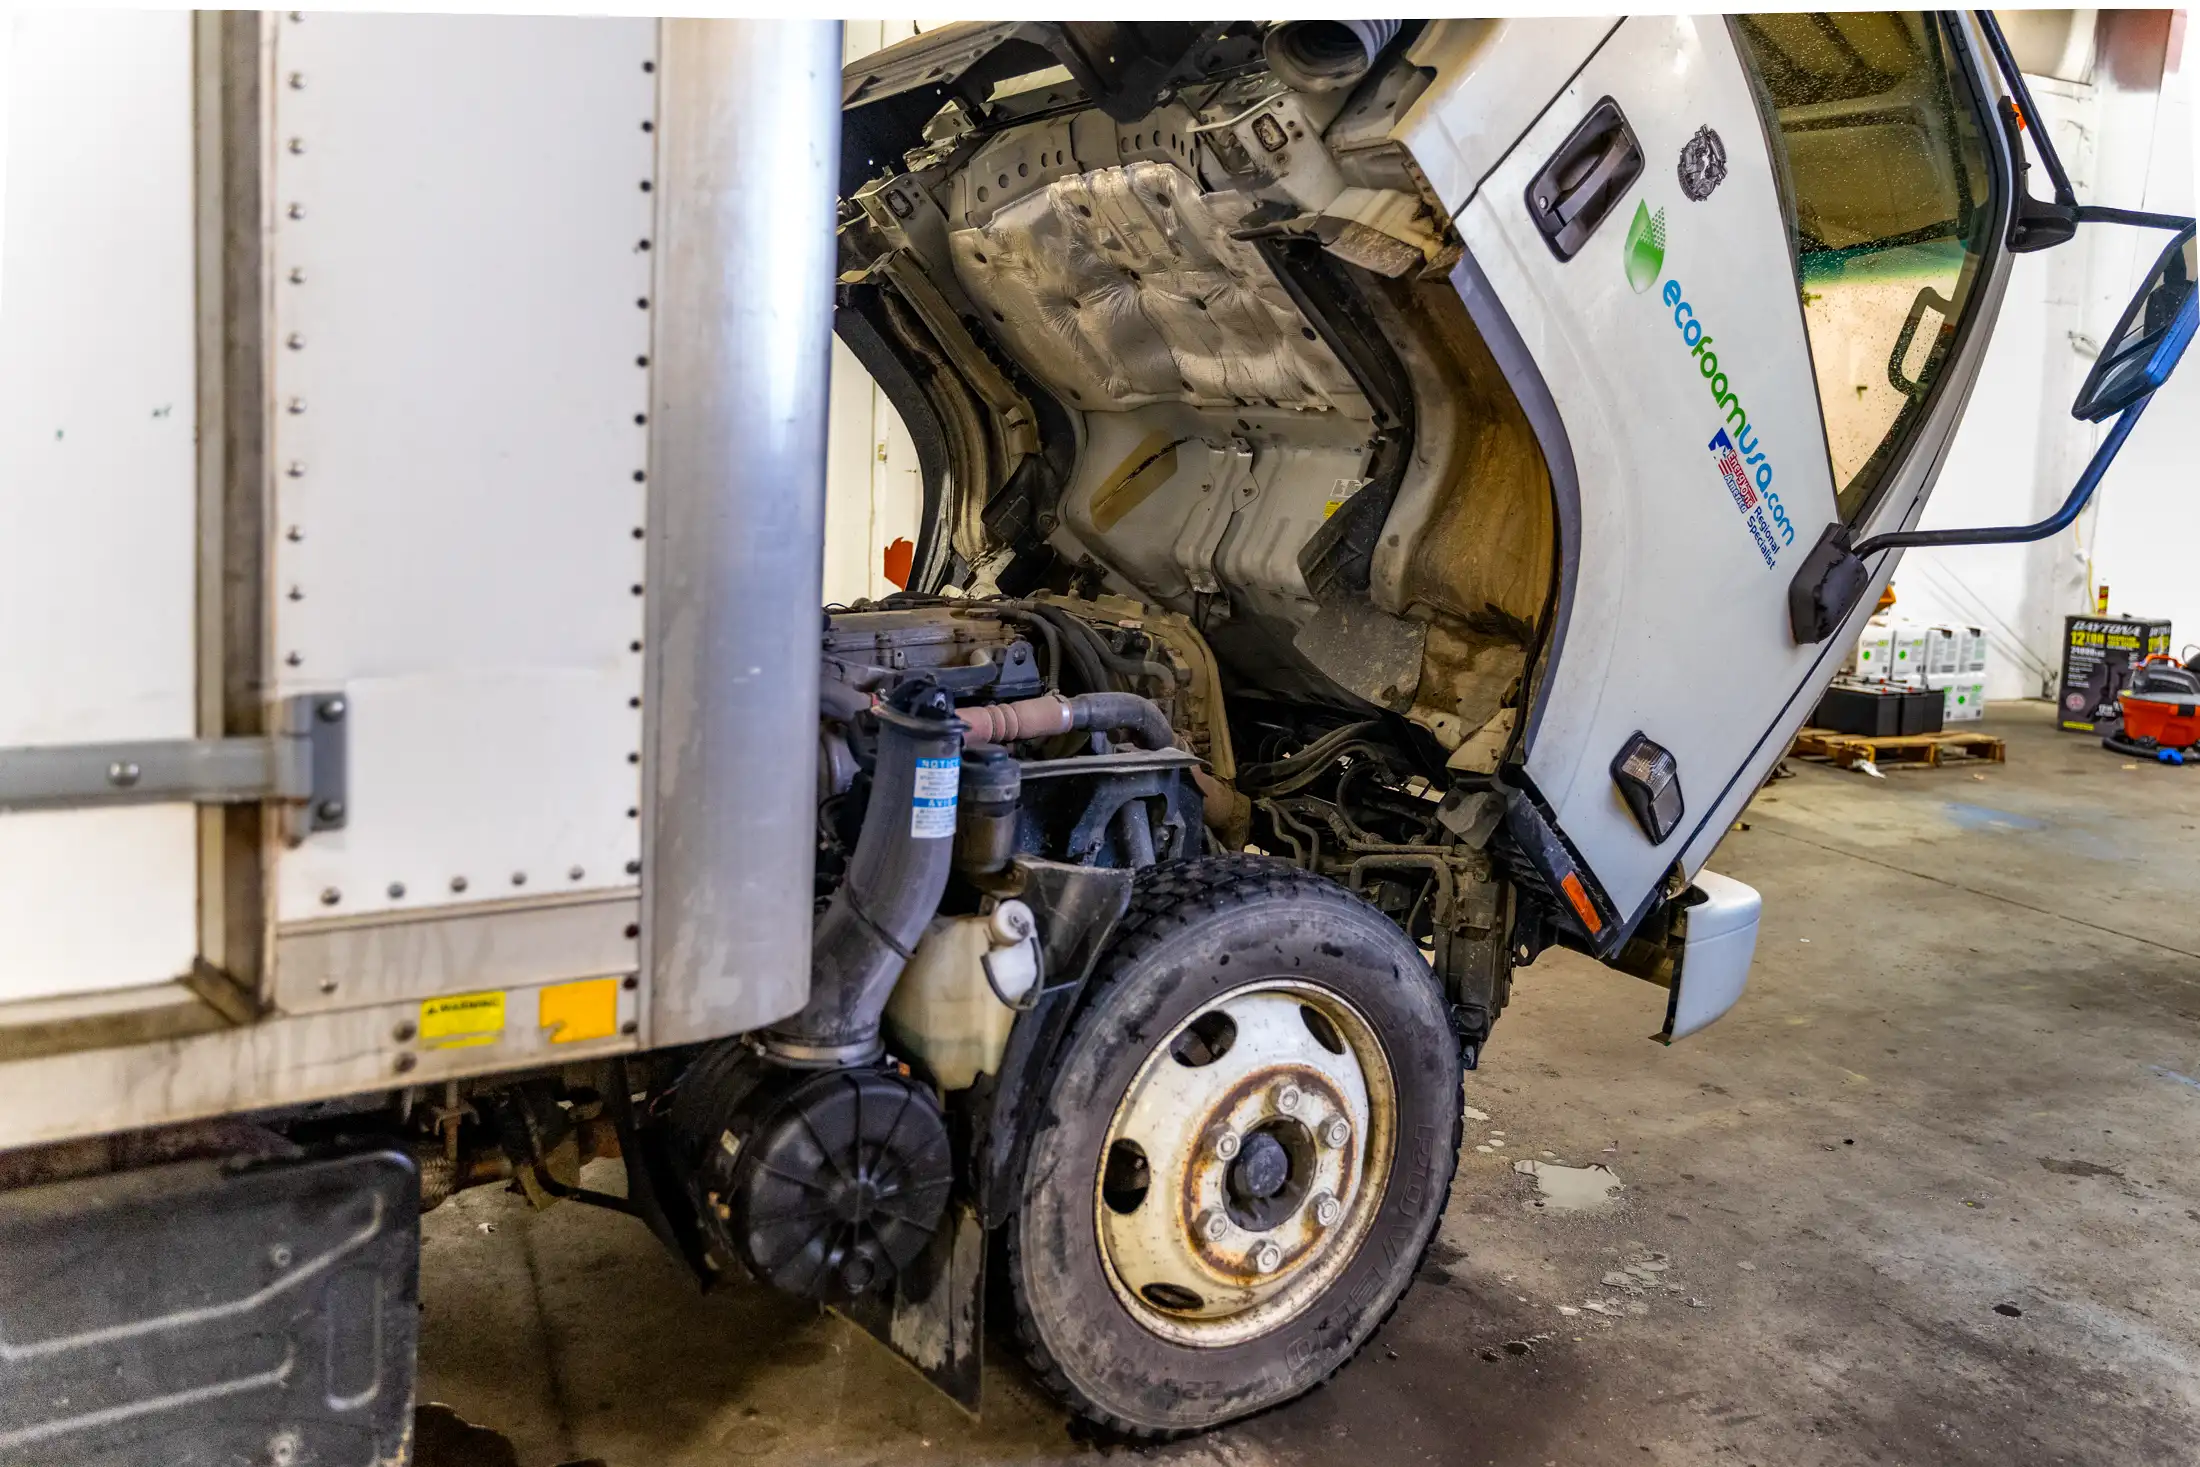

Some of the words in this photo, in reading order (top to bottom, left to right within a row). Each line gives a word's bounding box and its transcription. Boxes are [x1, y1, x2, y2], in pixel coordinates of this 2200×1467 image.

[1663, 279, 1795, 546] ecofoamusa.com
[1724, 473, 1748, 514] America
[1747, 515, 1776, 570] Specialist
[1754, 506, 1780, 554] Regional
[2071, 631, 2086, 646] 12
[2072, 621, 2141, 637] DAYTONA
[440, 999, 499, 1012] WARNING
